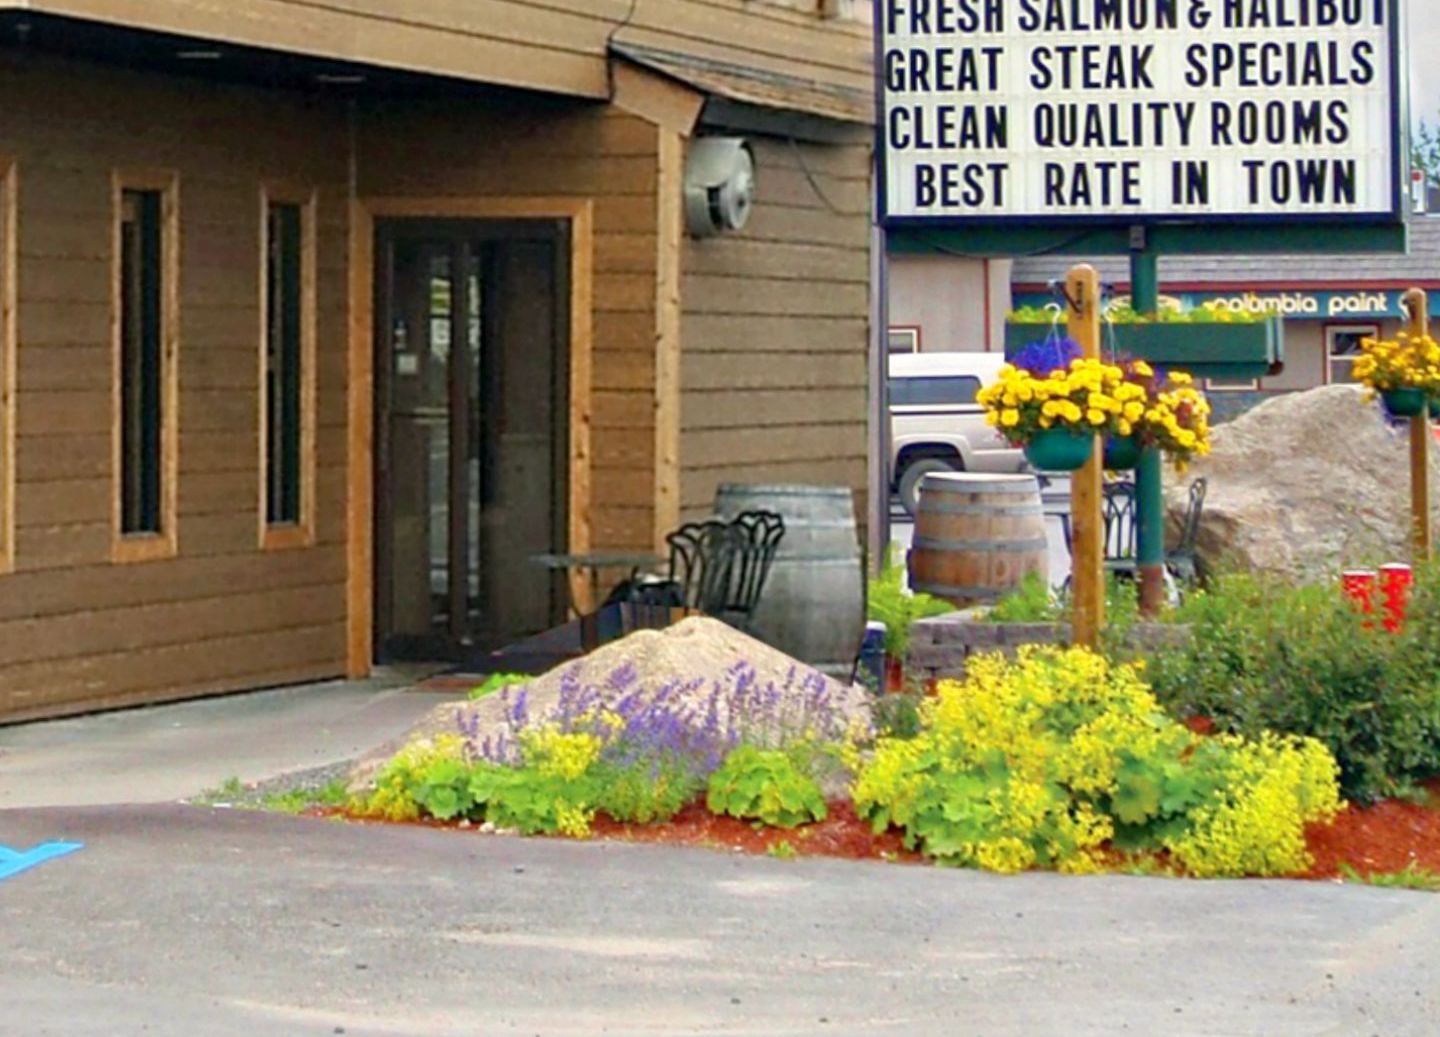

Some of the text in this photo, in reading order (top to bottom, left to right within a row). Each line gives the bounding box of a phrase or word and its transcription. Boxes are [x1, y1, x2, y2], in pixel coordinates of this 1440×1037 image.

[885, 40, 1374, 93] GREAT STEAK SPECIALS
[889, 100, 1349, 150] CLEAN QUALITY ROOMS
[915, 159, 1357, 208] BEST RATE IN TOWN
[1328, 291, 1388, 316] paint
